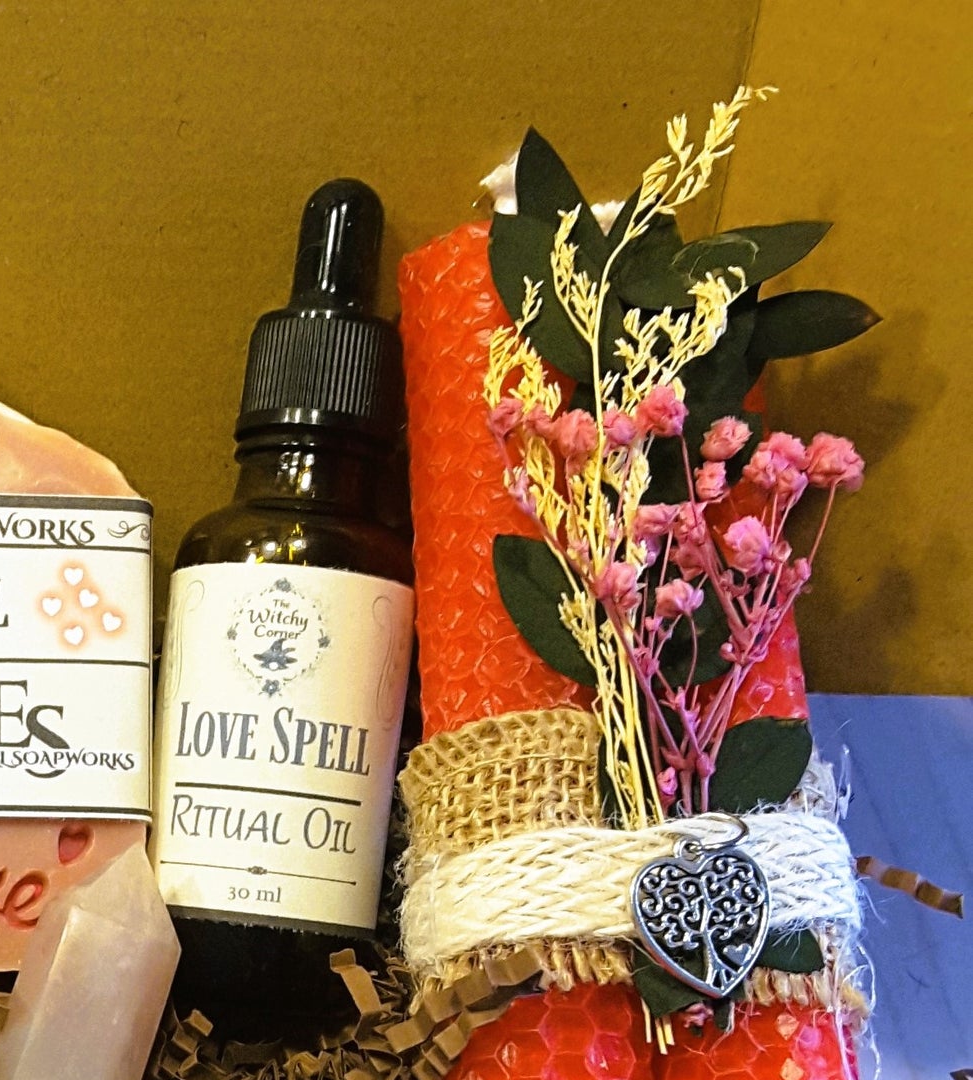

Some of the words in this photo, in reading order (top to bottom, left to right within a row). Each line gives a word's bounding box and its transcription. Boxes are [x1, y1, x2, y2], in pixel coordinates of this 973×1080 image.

[247, 608, 309, 633] Witchy
[253, 624, 302, 641] Corner
[226, 887, 250, 902] 30
[256, 886, 283, 904] ml
